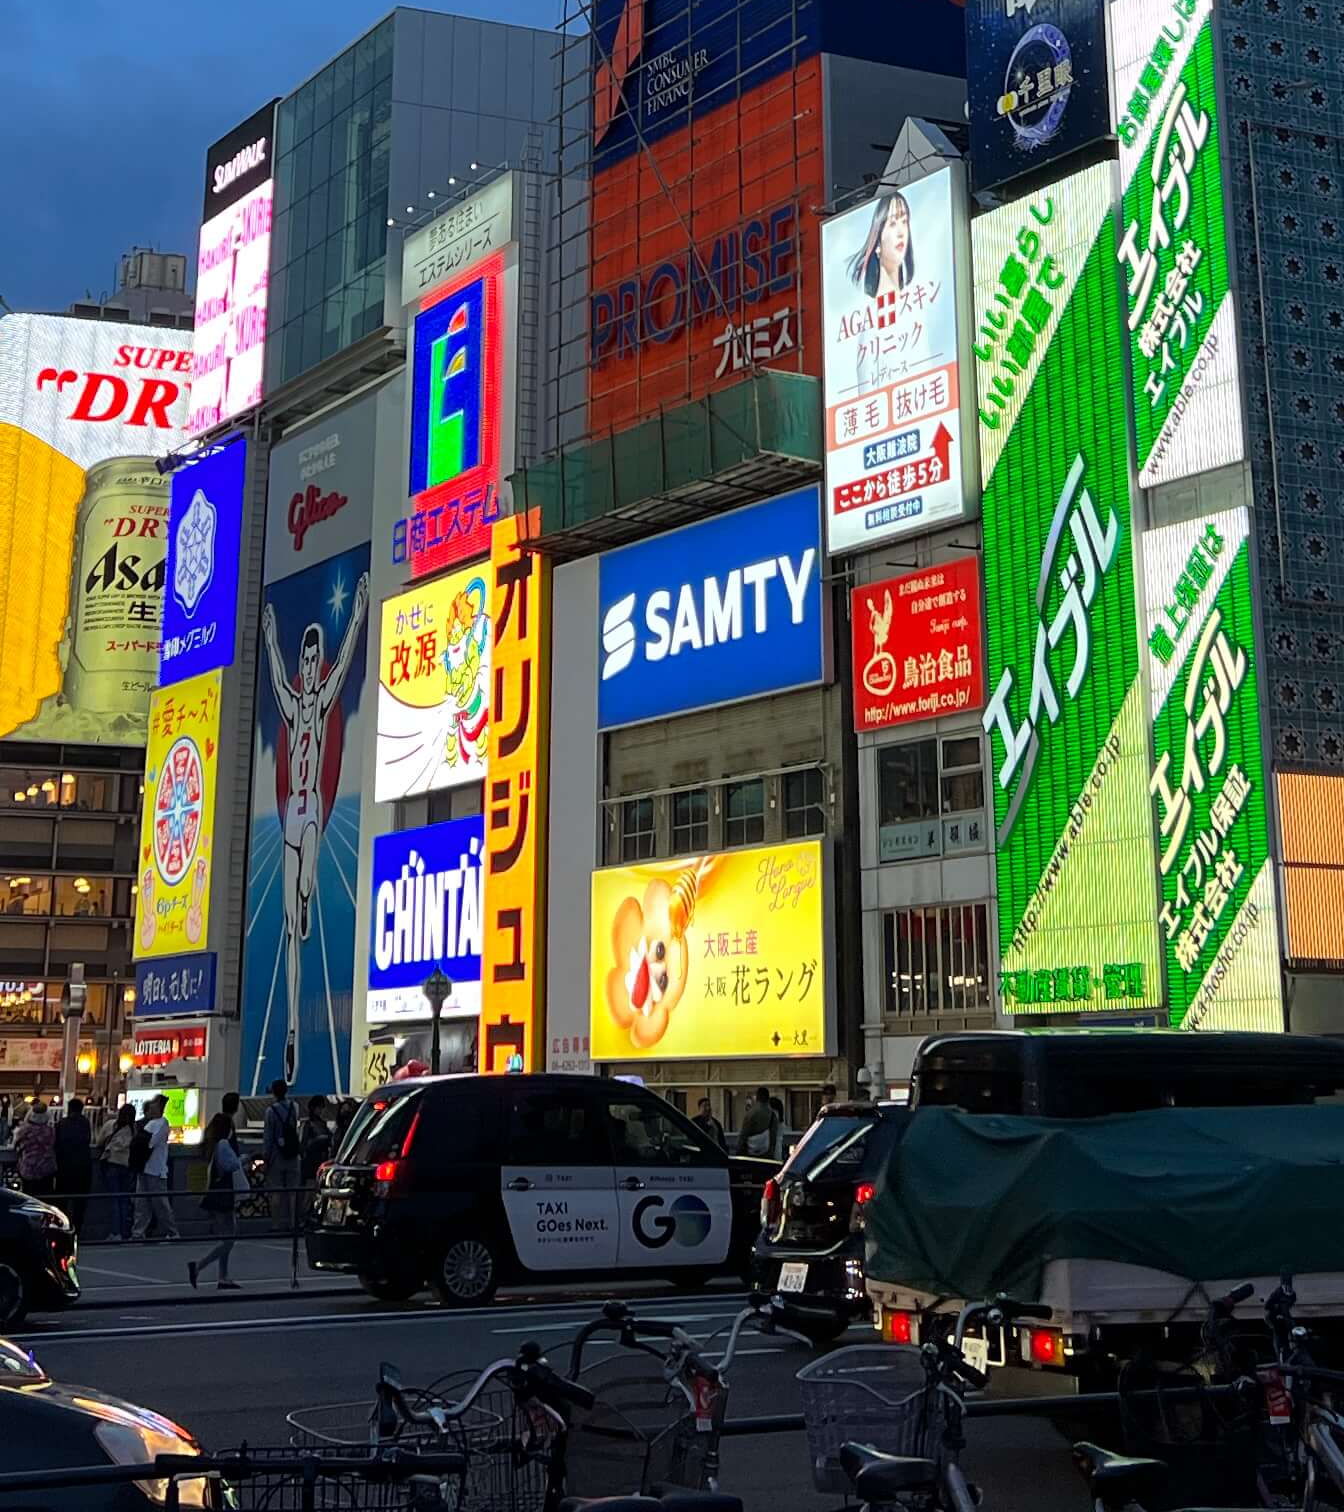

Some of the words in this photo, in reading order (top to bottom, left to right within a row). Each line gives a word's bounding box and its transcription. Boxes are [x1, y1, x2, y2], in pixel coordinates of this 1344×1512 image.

[427, 201, 482, 252] 夢ある住まい
[1117, 99, 1209, 294] エイブル
[418, 229, 492, 287] エステムシリーズ
[589, 204, 796, 368] PROMISE
[971, 197, 1056, 365] いい暮らし
[838, 306, 874, 343] AGA
[899, 280, 945, 324] スキン
[1137, 239, 1203, 359] 株式会社
[713, 307, 796, 379] プロミス
[857, 320, 923, 368] クリニック
[871, 360, 908, 386] レディース
[978, 256, 1066, 431] いい部屋で
[1144, 290, 1203, 406] エイブル
[843, 399, 881, 439] 薄毛
[896, 376, 945, 419] 抜け毛
[1146, 333, 1220, 477] www.able.co.jp
[866, 432, 919, 467] 大阪難波院
[839, 456, 944, 508] ここから徒歩5分
[288, 484, 348, 551] Glico
[392, 483, 504, 565] 日商エステム
[128, 601, 157, 621] 生
[395, 600, 435, 635] かぜに
[645, 549, 817, 660] SAMTY
[389, 630, 438, 688] 改源
[983, 487, 1121, 789] エイブル
[864, 686, 970, 723] http://www.toriji.co.jp/
[1149, 629, 1248, 837] エイブル
[297, 725, 312, 816] グリコ
[1011, 732, 1123, 956] http://www.able.co.jp
[1159, 762, 1254, 938] エイブル保証
[1174, 847, 1245, 974] 株式会社
[704, 929, 758, 959] 大阪土産
[135, 1039, 171, 1055] LOTTERIA
[536, 1201, 568, 1215] TAXI
[536, 1219, 572, 1233] GOes
[575, 1218, 609, 1231] Next.
[632, 1194, 712, 1249] GO
